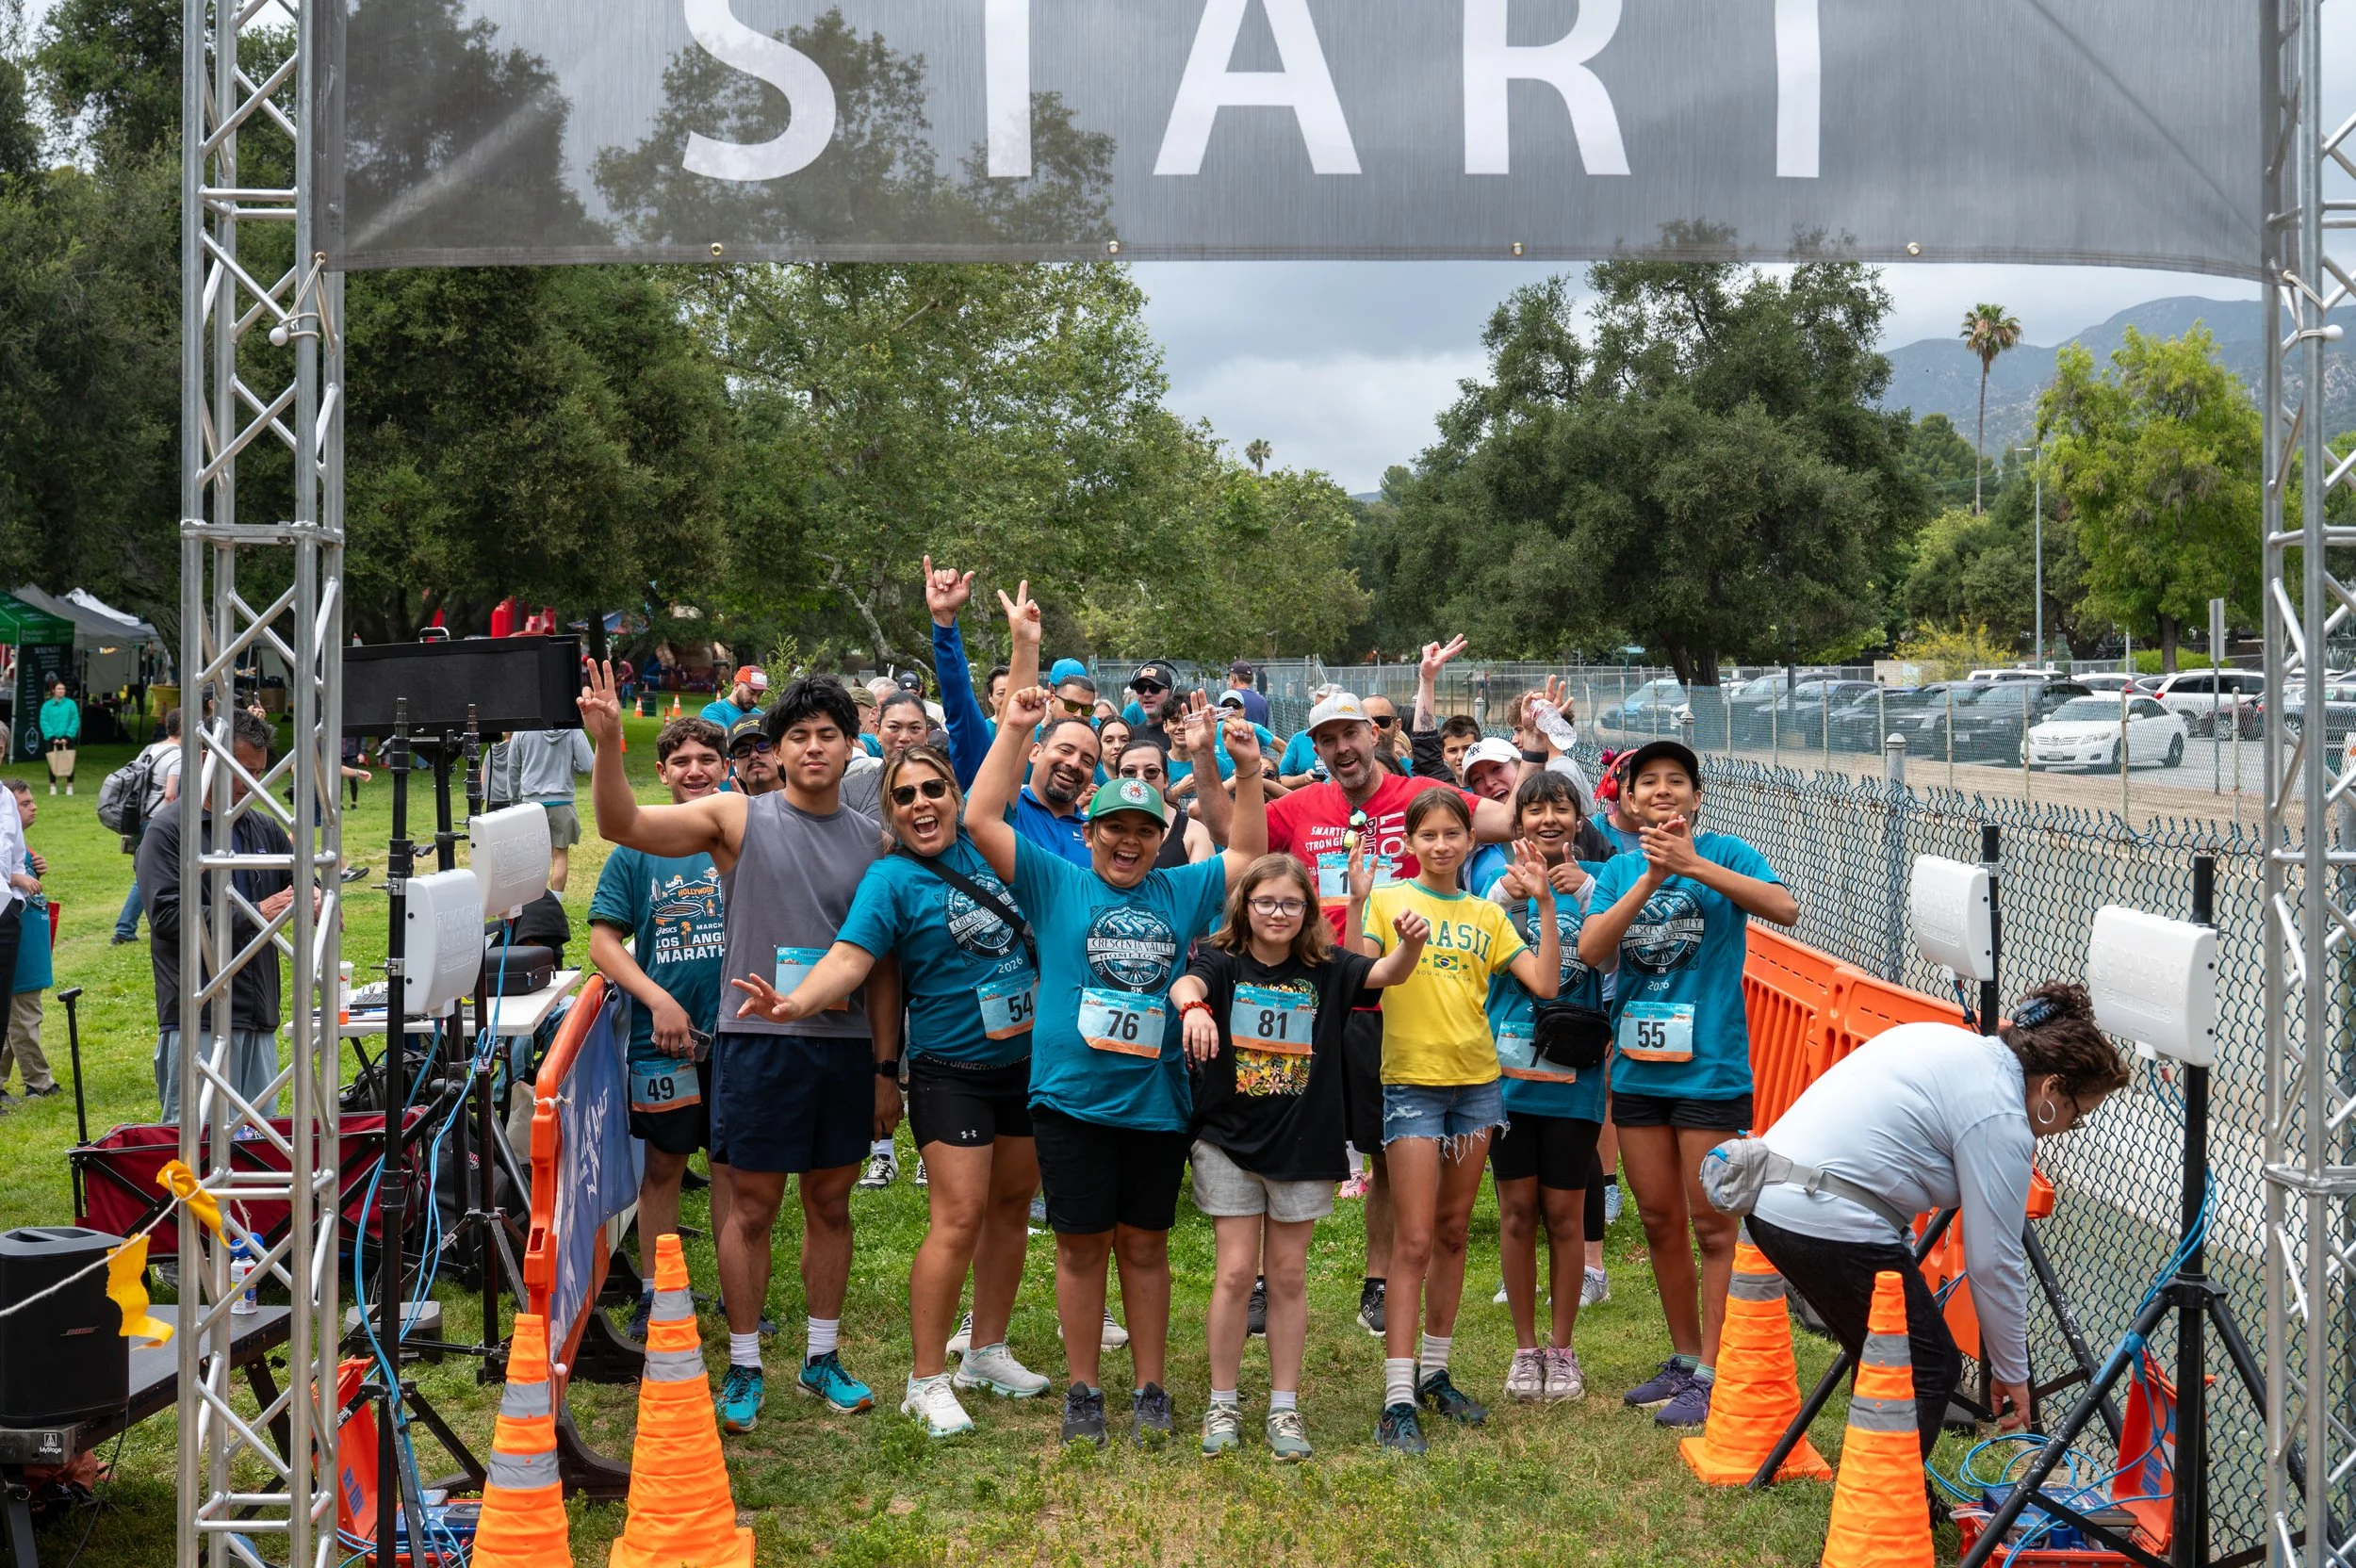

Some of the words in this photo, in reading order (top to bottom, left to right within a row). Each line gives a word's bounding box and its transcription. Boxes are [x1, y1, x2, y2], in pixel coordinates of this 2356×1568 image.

[1311, 826, 1348, 837] SMARTE
[679, 887, 714, 897] HOLLYWOOD
[656, 937, 679, 949] LOS
[1144, 942, 1173, 954] VALLEY
[1398, 918, 1492, 964] ASIL
[999, 947, 1010, 956] 5K
[999, 956, 1023, 973] 2026
[1415, 969, 1440, 977] SOUH
[1007, 990, 1034, 1022] 54
[1107, 1009, 1139, 1041] 76
[1257, 1009, 1288, 1039] 81
[1637, 1021, 1665, 1049] 55
[646, 1076, 676, 1102] 49
